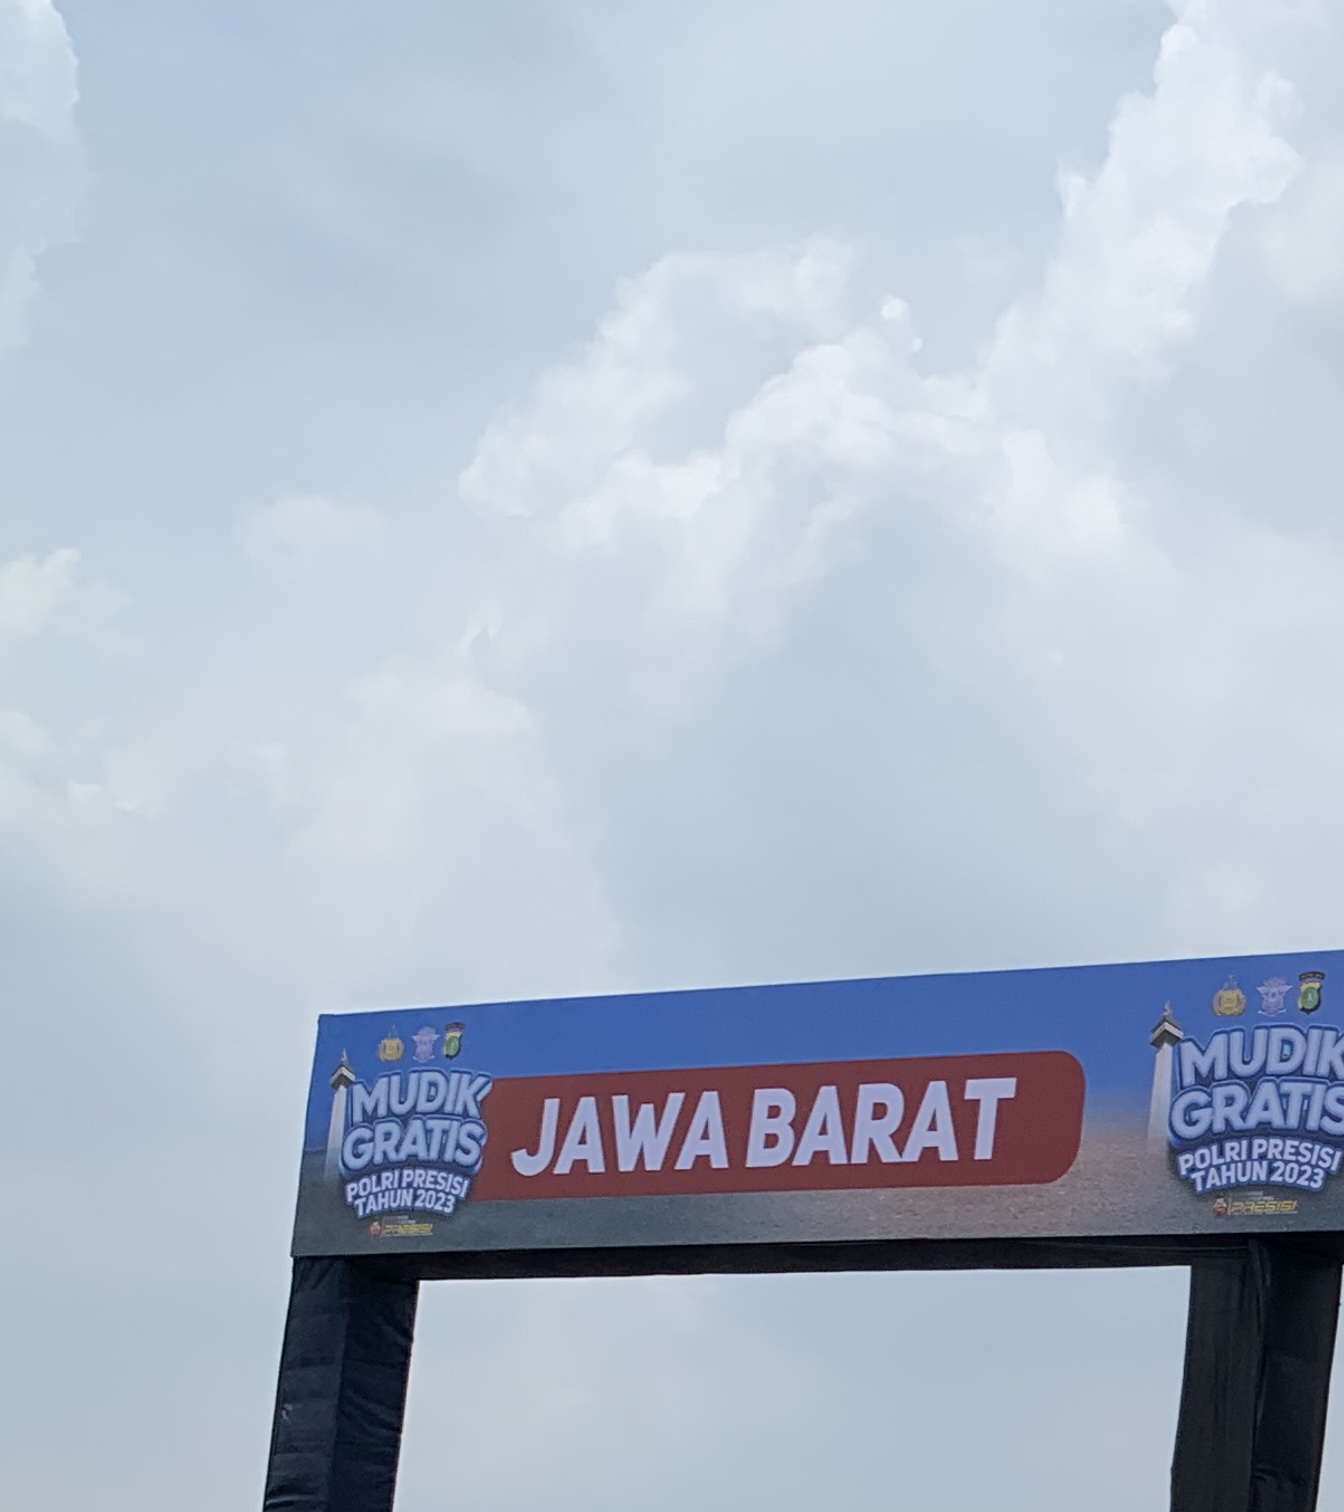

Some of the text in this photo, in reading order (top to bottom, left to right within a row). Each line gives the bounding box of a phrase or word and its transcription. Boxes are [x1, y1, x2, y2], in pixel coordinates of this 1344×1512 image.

[351, 1069, 491, 1124] MUDIK
[342, 1116, 487, 1171] GRATIS
[510, 1076, 1017, 1177] JAWA BARAT
[1178, 1138, 1343, 1176] POLRI PRESISI
[1191, 1160, 1324, 1192] TAHUN 2023
[347, 1168, 469, 1202] POLRI PRESISI
[355, 1189, 455, 1216] TAHUN 2023
